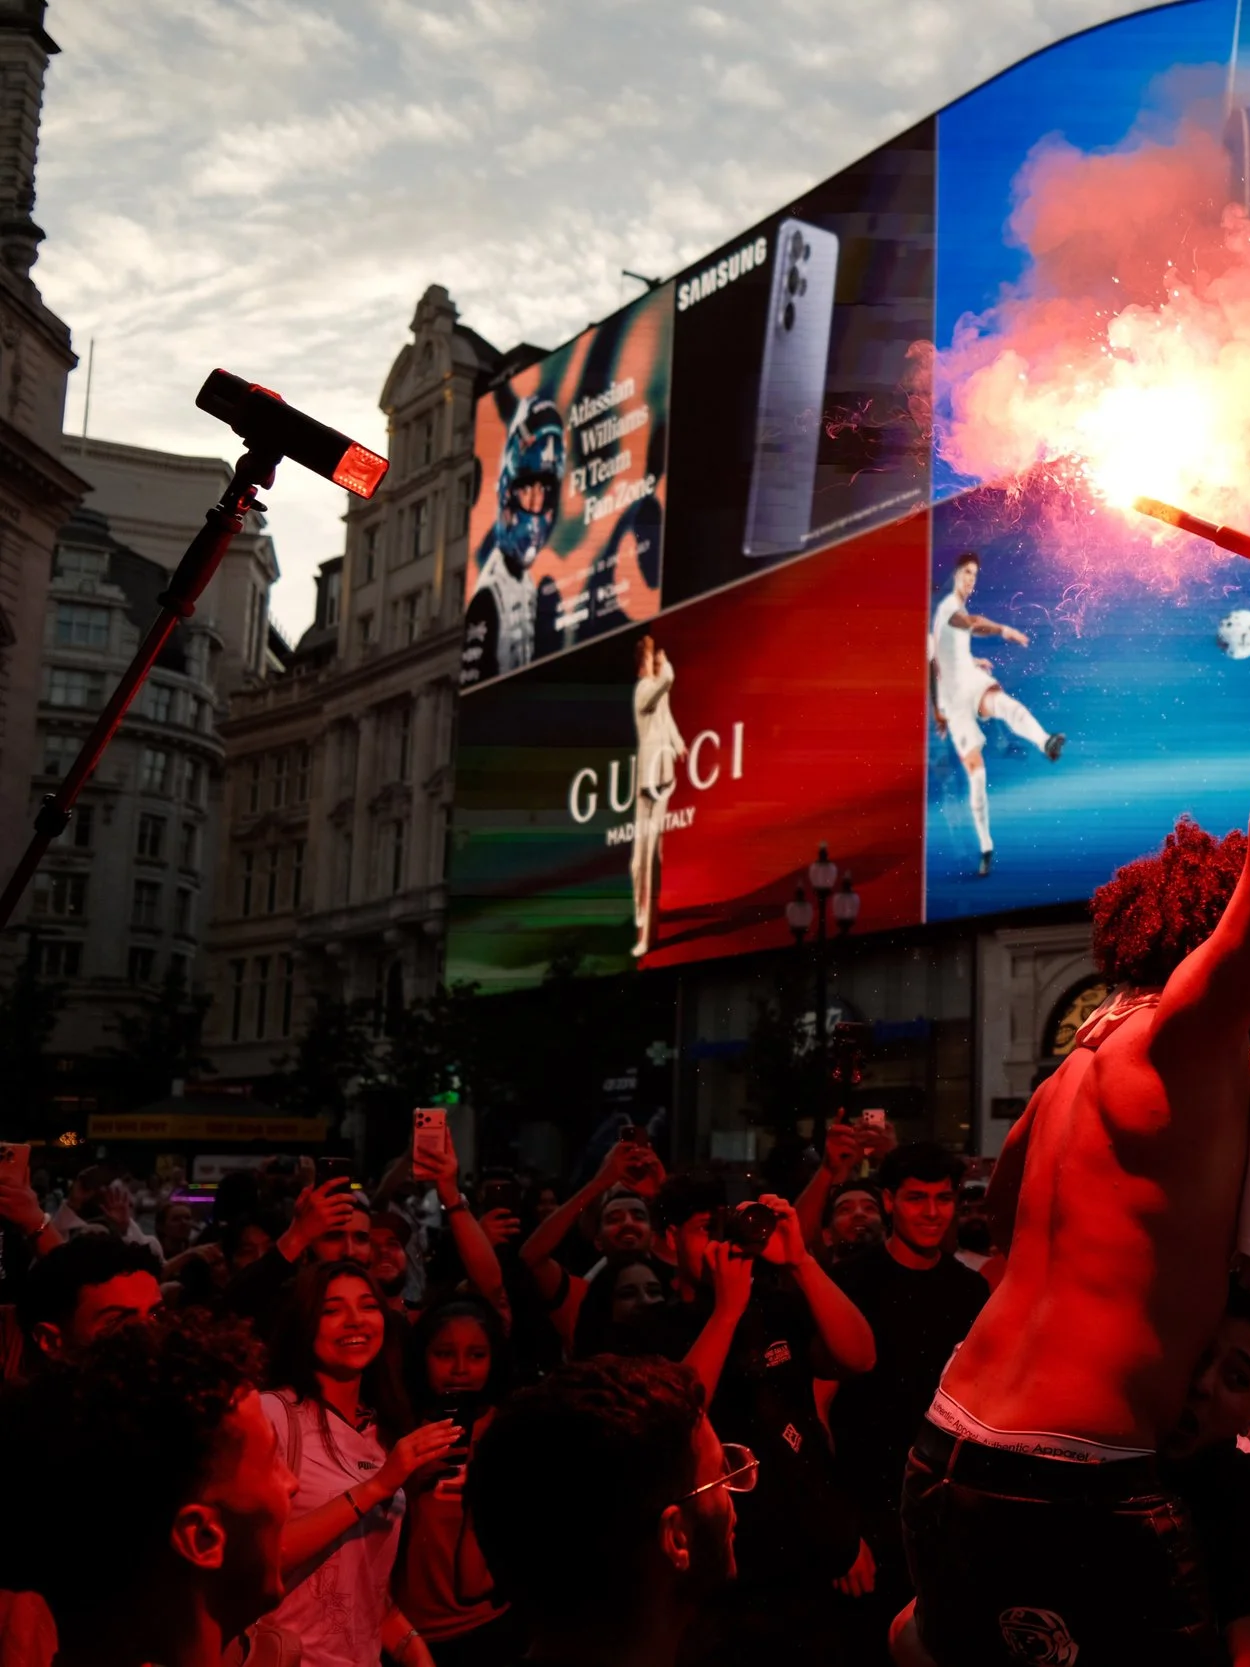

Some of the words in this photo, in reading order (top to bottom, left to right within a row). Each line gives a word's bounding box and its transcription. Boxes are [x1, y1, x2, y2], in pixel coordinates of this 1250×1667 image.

[678, 236, 767, 312] SAMSUNG
[568, 377, 635, 429] Atlassian
[580, 404, 649, 455] Williams
[569, 467, 586, 498] F1
[589, 450, 632, 487] Team
[584, 491, 614, 525] Fan
[613, 474, 656, 510] Zone
[569, 721, 744, 824] GUCCI
[606, 822, 640, 847] MAD
[1031, 1443, 1089, 1462] Apparel
